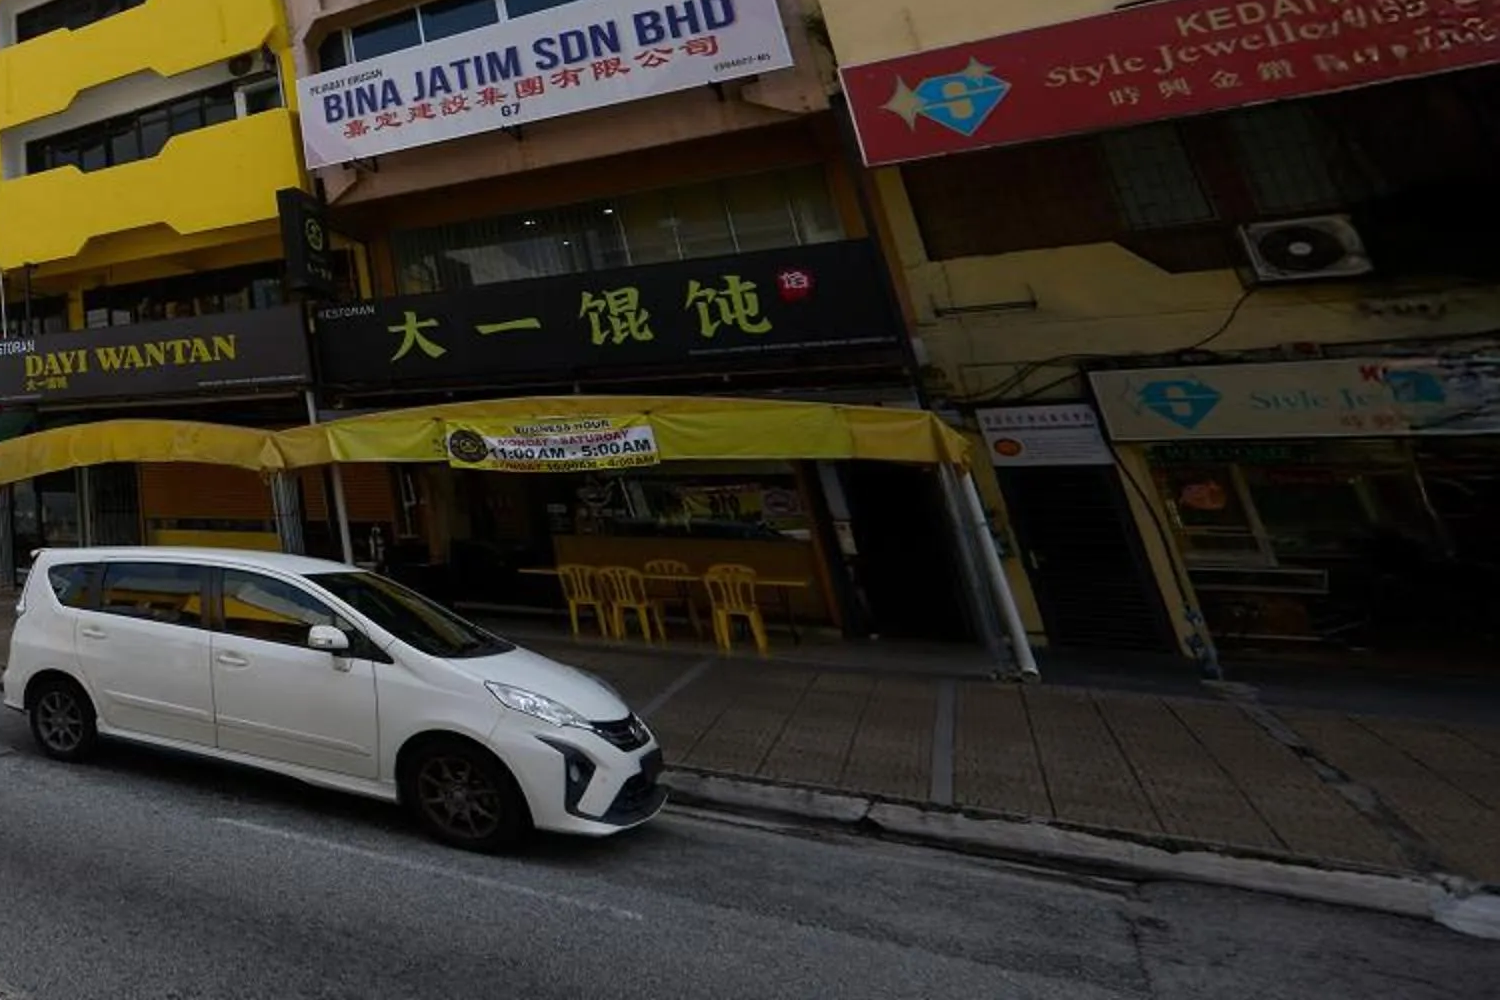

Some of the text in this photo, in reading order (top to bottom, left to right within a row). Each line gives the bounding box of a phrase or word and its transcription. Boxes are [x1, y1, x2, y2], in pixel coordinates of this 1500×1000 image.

[323, 78, 402, 124] BINA
[413, 46, 523, 102] JATIM
[532, 20, 622, 71] SDN
[1045, 53, 1146, 89] Style
[388, 274, 772, 362] 大一馄饨
[24, 334, 237, 378] DAYI WANTAN
[560, 429, 630, 446] SATURDAY
